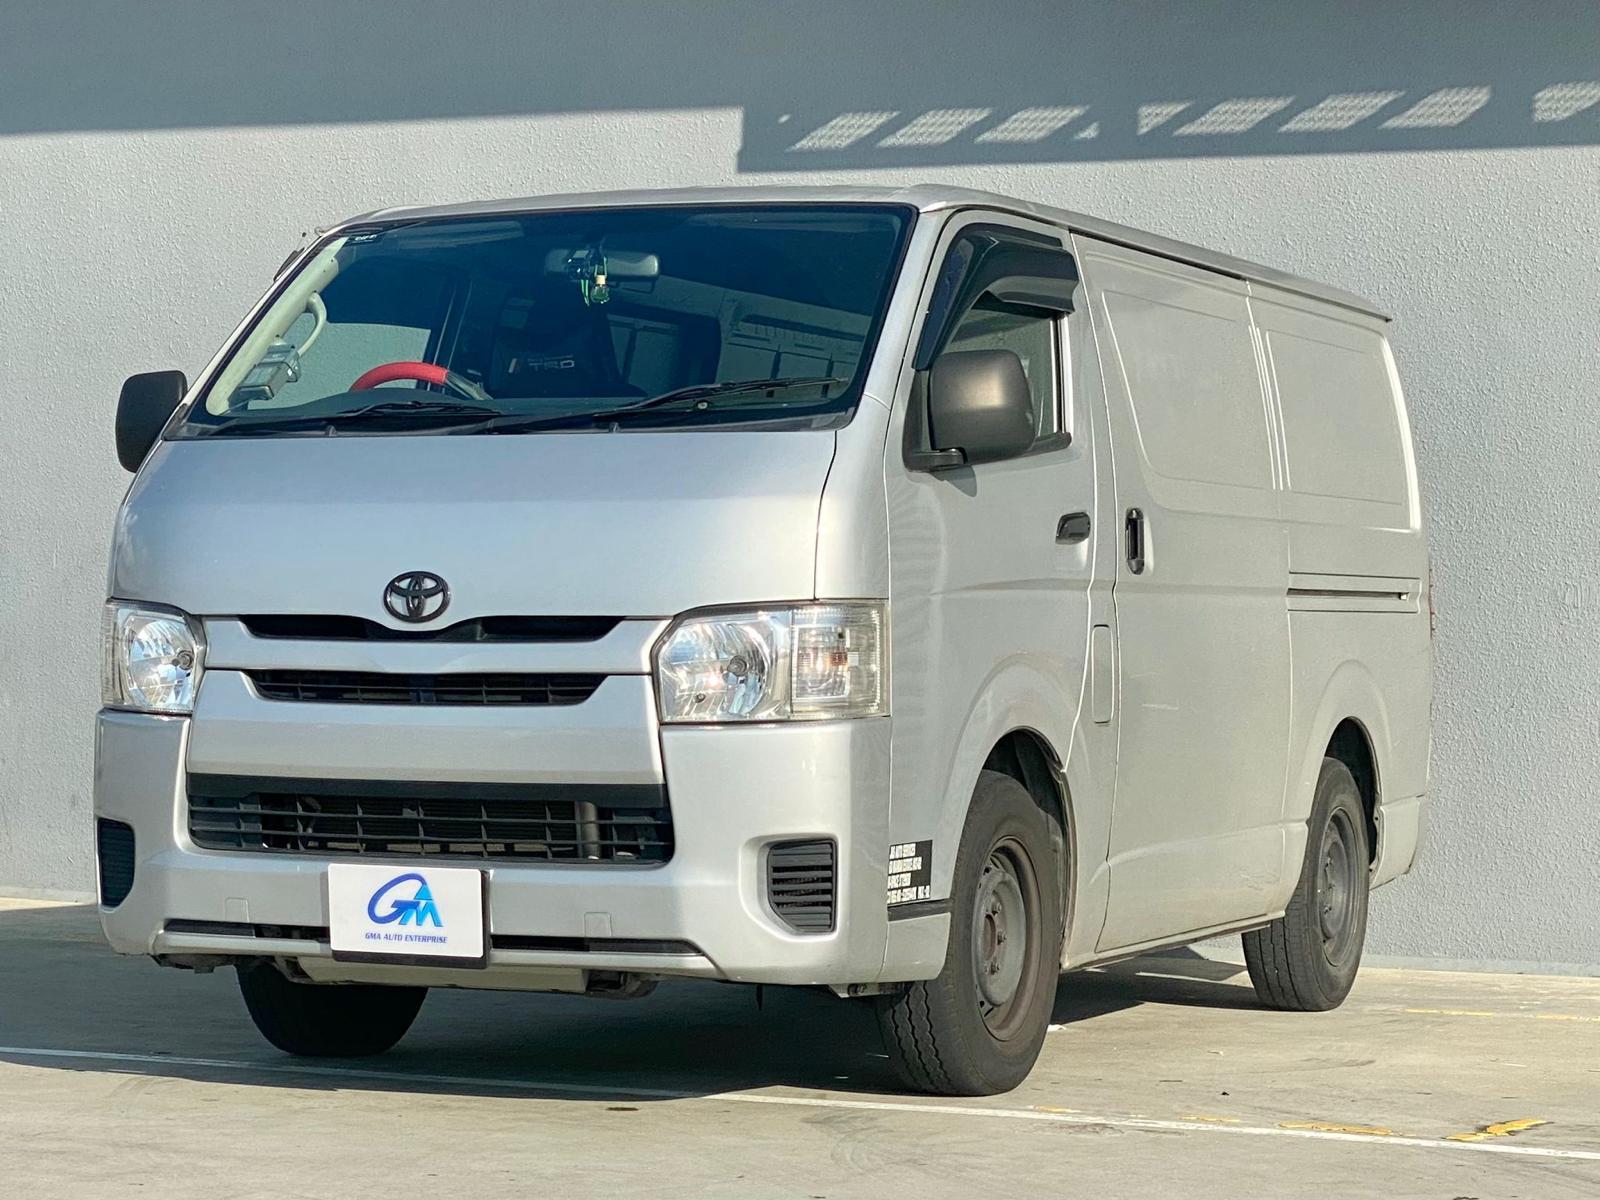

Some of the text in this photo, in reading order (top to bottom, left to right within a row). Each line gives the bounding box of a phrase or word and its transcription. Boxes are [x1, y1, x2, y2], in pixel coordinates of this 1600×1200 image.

[365, 932, 448, 944] GMA AUTO ENTERPRISE
